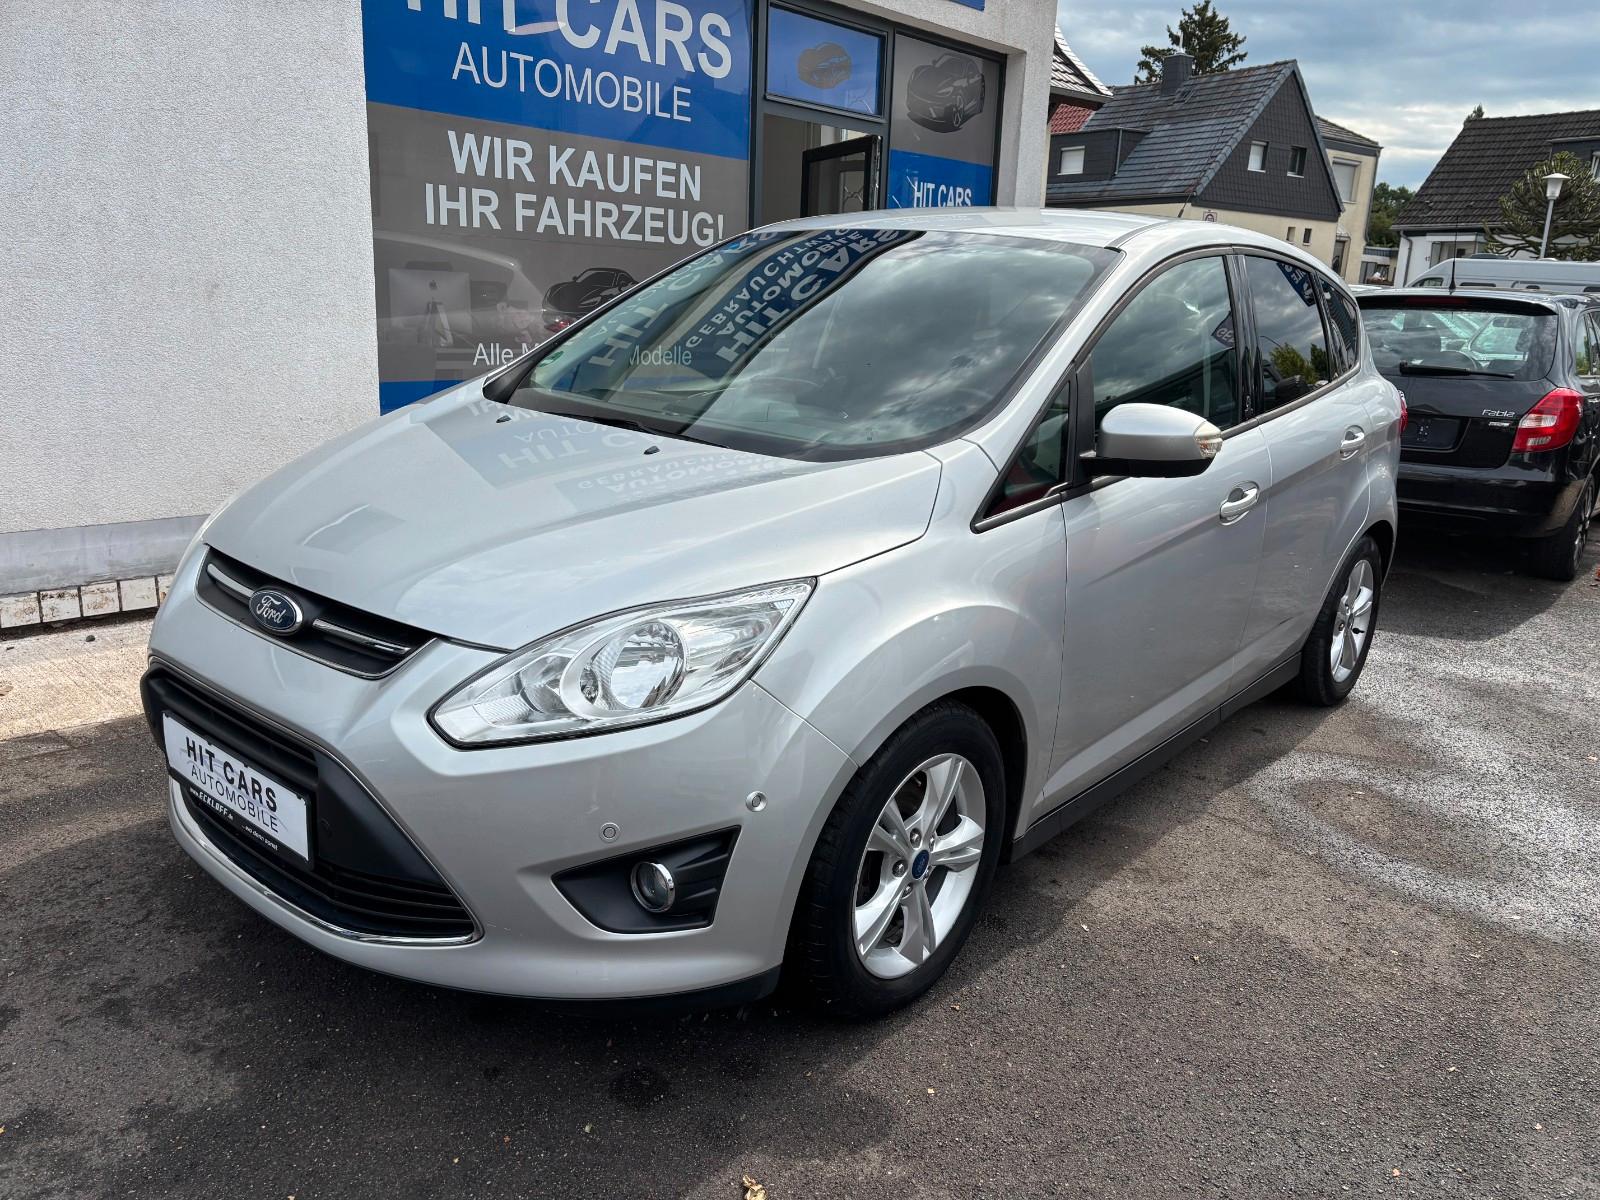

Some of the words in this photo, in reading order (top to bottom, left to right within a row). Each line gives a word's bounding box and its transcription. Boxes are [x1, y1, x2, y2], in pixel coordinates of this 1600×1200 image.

[555, 0, 732, 79] CARS
[451, 41, 692, 122] AUTOMOBILE
[447, 130, 535, 183] WIR
[549, 145, 701, 201] KAUFEN
[913, 181, 936, 208] HIT
[938, 184, 972, 208] CARS
[425, 183, 500, 230] IHR
[515, 192, 724, 246] FAHRZEUG!
[472, 342, 514, 366] Alle
[1481, 409, 1516, 418] Fabia
[256, 595, 287, 624] Ford
[186, 736, 215, 773] HIT
[223, 761, 278, 813] CARS
[191, 764, 279, 834] AUTOMOBILE
